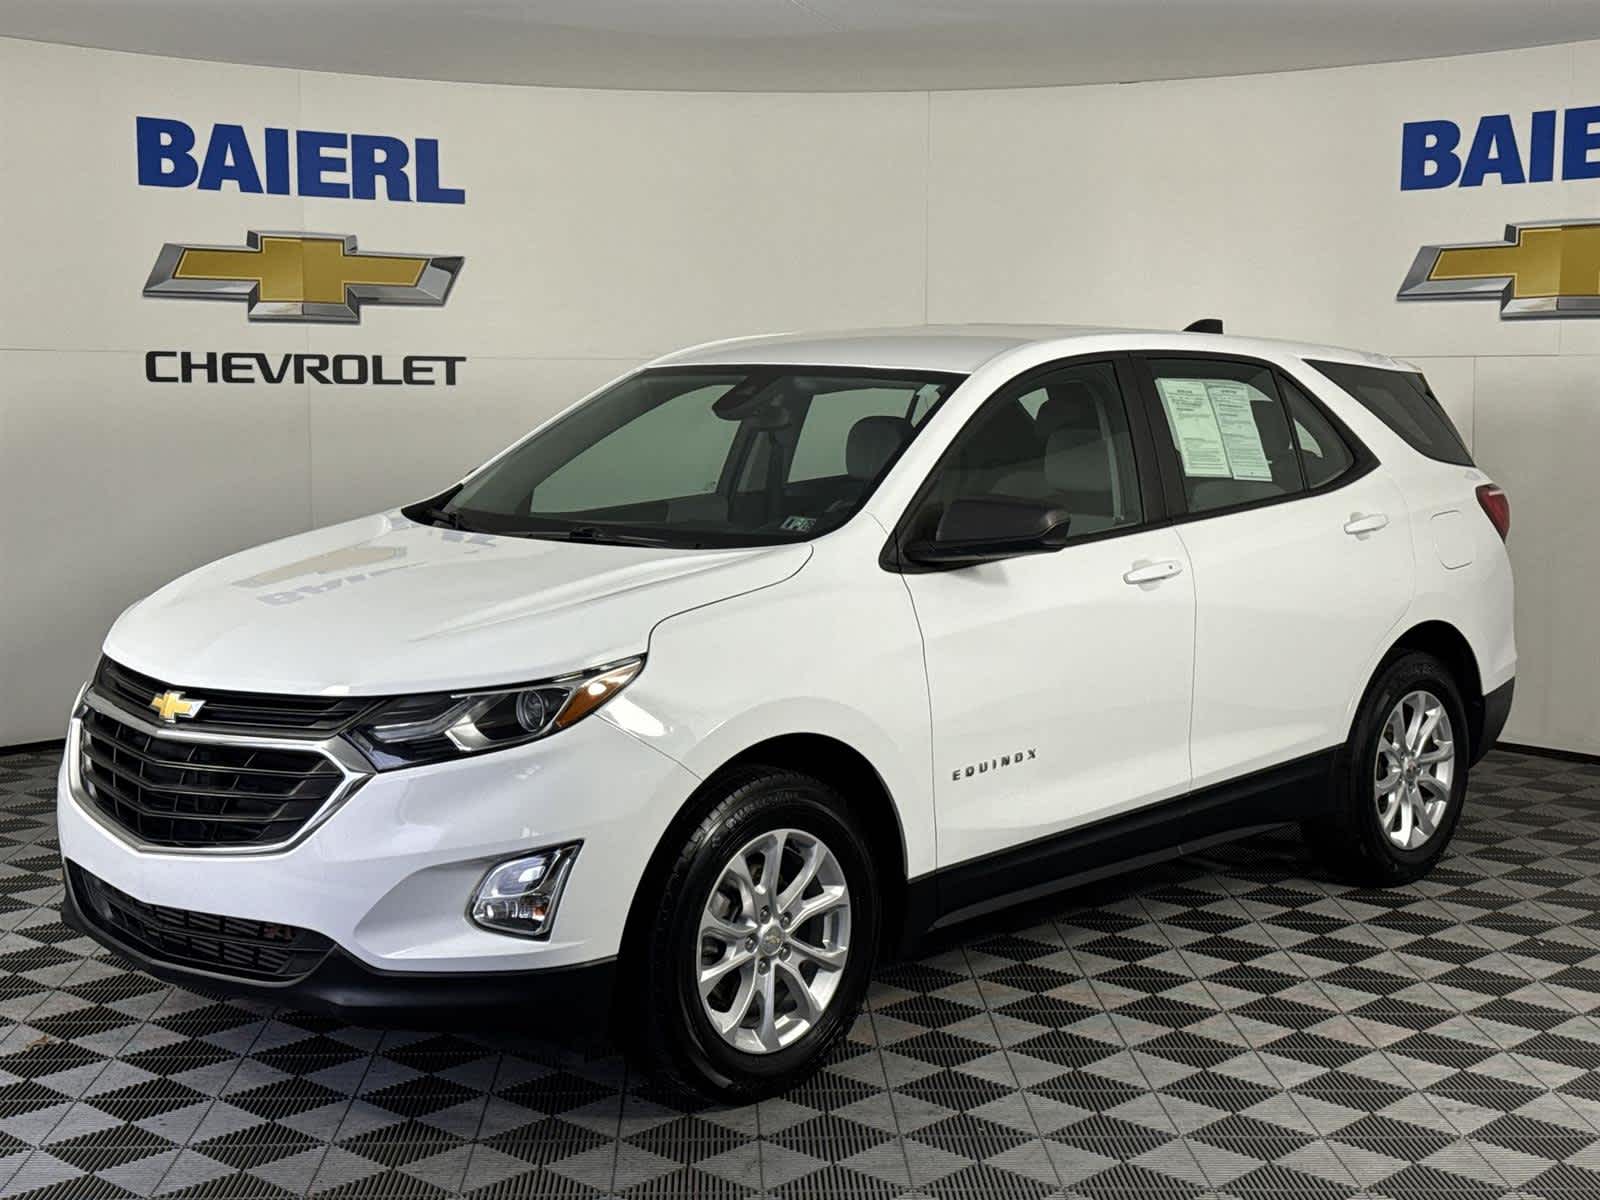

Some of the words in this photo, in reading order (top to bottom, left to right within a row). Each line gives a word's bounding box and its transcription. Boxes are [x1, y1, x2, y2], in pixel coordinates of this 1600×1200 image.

[136, 116, 465, 204] BAIERL
[145, 351, 466, 385] CHEVROLET
[952, 748, 1036, 781] EQUINOX
